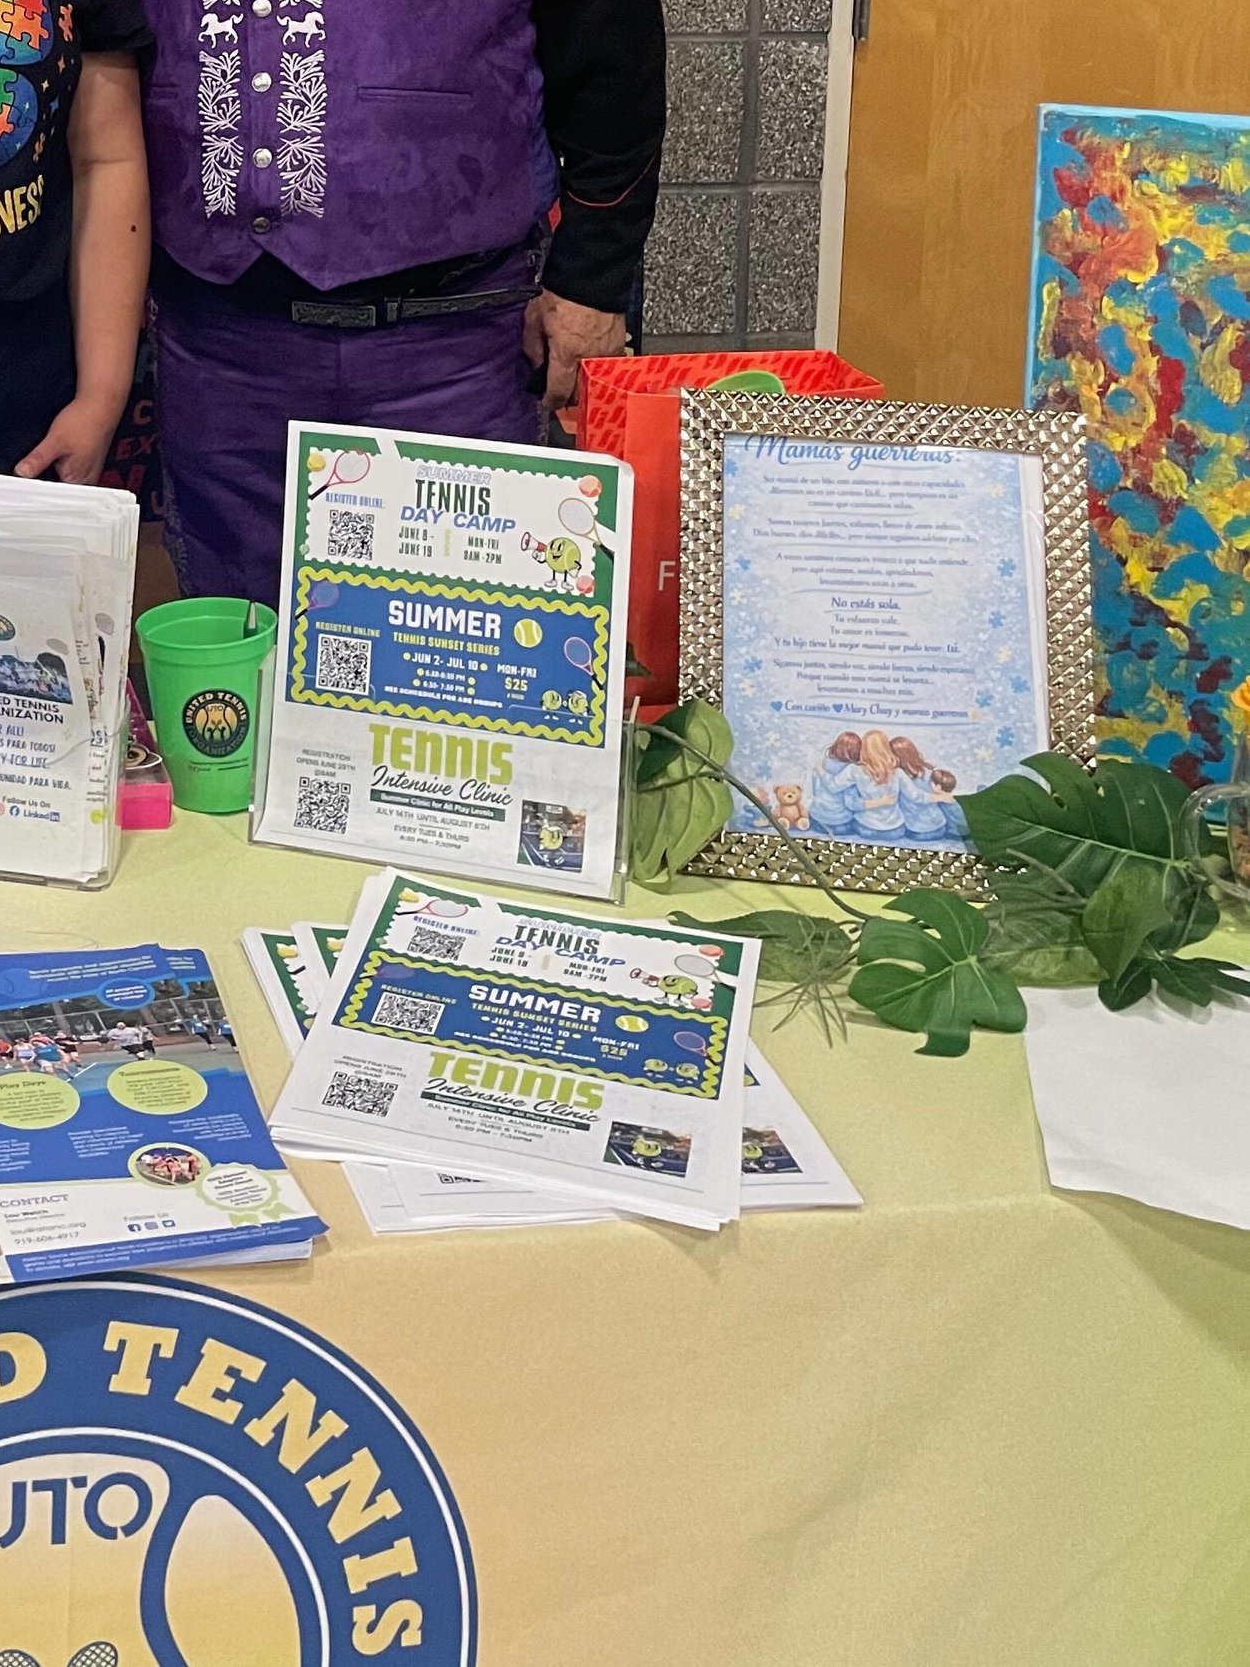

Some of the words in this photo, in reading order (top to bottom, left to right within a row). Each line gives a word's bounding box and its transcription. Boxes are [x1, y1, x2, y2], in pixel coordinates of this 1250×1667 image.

[417, 465, 491, 484] SUMMER
[415, 479, 491, 516] TENNIS
[400, 505, 444, 524] DAY
[453, 513, 516, 533] CAMP
[399, 543, 420, 557] JUNE
[388, 600, 501, 639] SUMMER
[393, 632, 426, 646] TENNIS
[428, 636, 464, 652] SUNSET
[466, 641, 500, 655] SERIES
[412, 652, 431, 665] JUN
[446, 656, 465, 670] JUL
[497, 663, 538, 678] MON-FRI
[504, 676, 528, 692] $25
[15, 698, 60, 713] TENNIS
[371, 765, 454, 797] Intensive
[459, 778, 513, 806] Clinic
[495, 936, 546, 951] DAY
[554, 948, 626, 967] CAMP
[513, 924, 600, 955] TENNIS
[468, 984, 601, 1024] SUMMER
[425, 1077, 526, 1108] Intensive
[533, 1100, 601, 1122] Clinic
[0, 1193, 70, 1208] CONTACT
[104, 1321, 423, 1657] TENNIS
